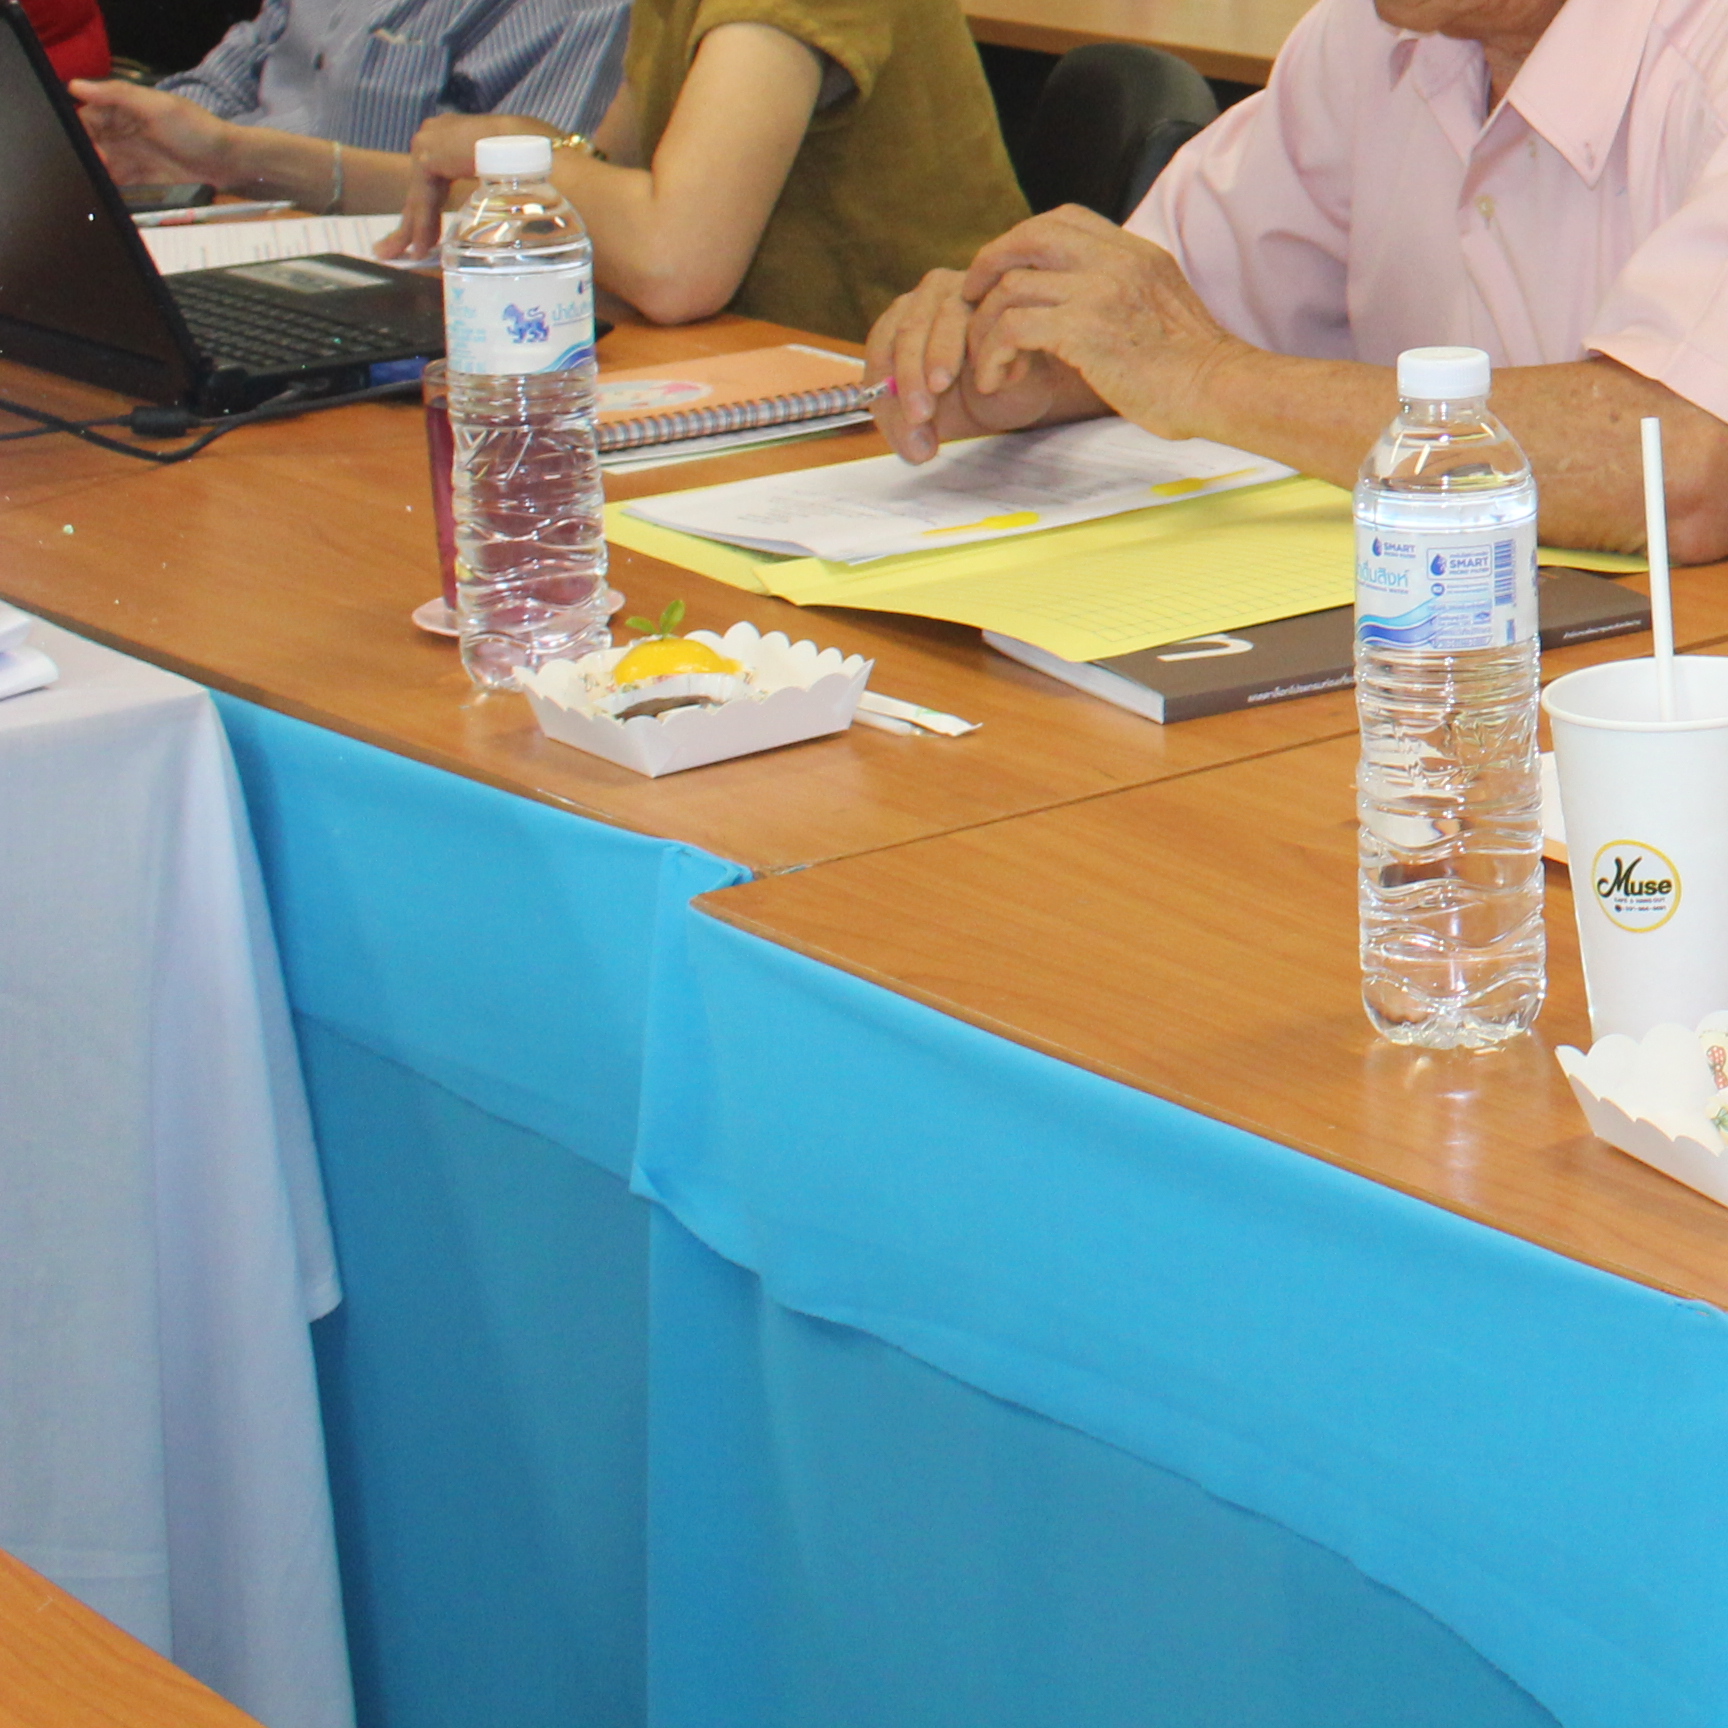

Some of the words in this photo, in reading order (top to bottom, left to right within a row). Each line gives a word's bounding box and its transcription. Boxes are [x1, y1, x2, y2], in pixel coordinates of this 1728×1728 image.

[1384, 542, 1416, 552] SMART
[1449, 557, 1488, 569] SMART
[1596, 855, 1673, 898] Muse
